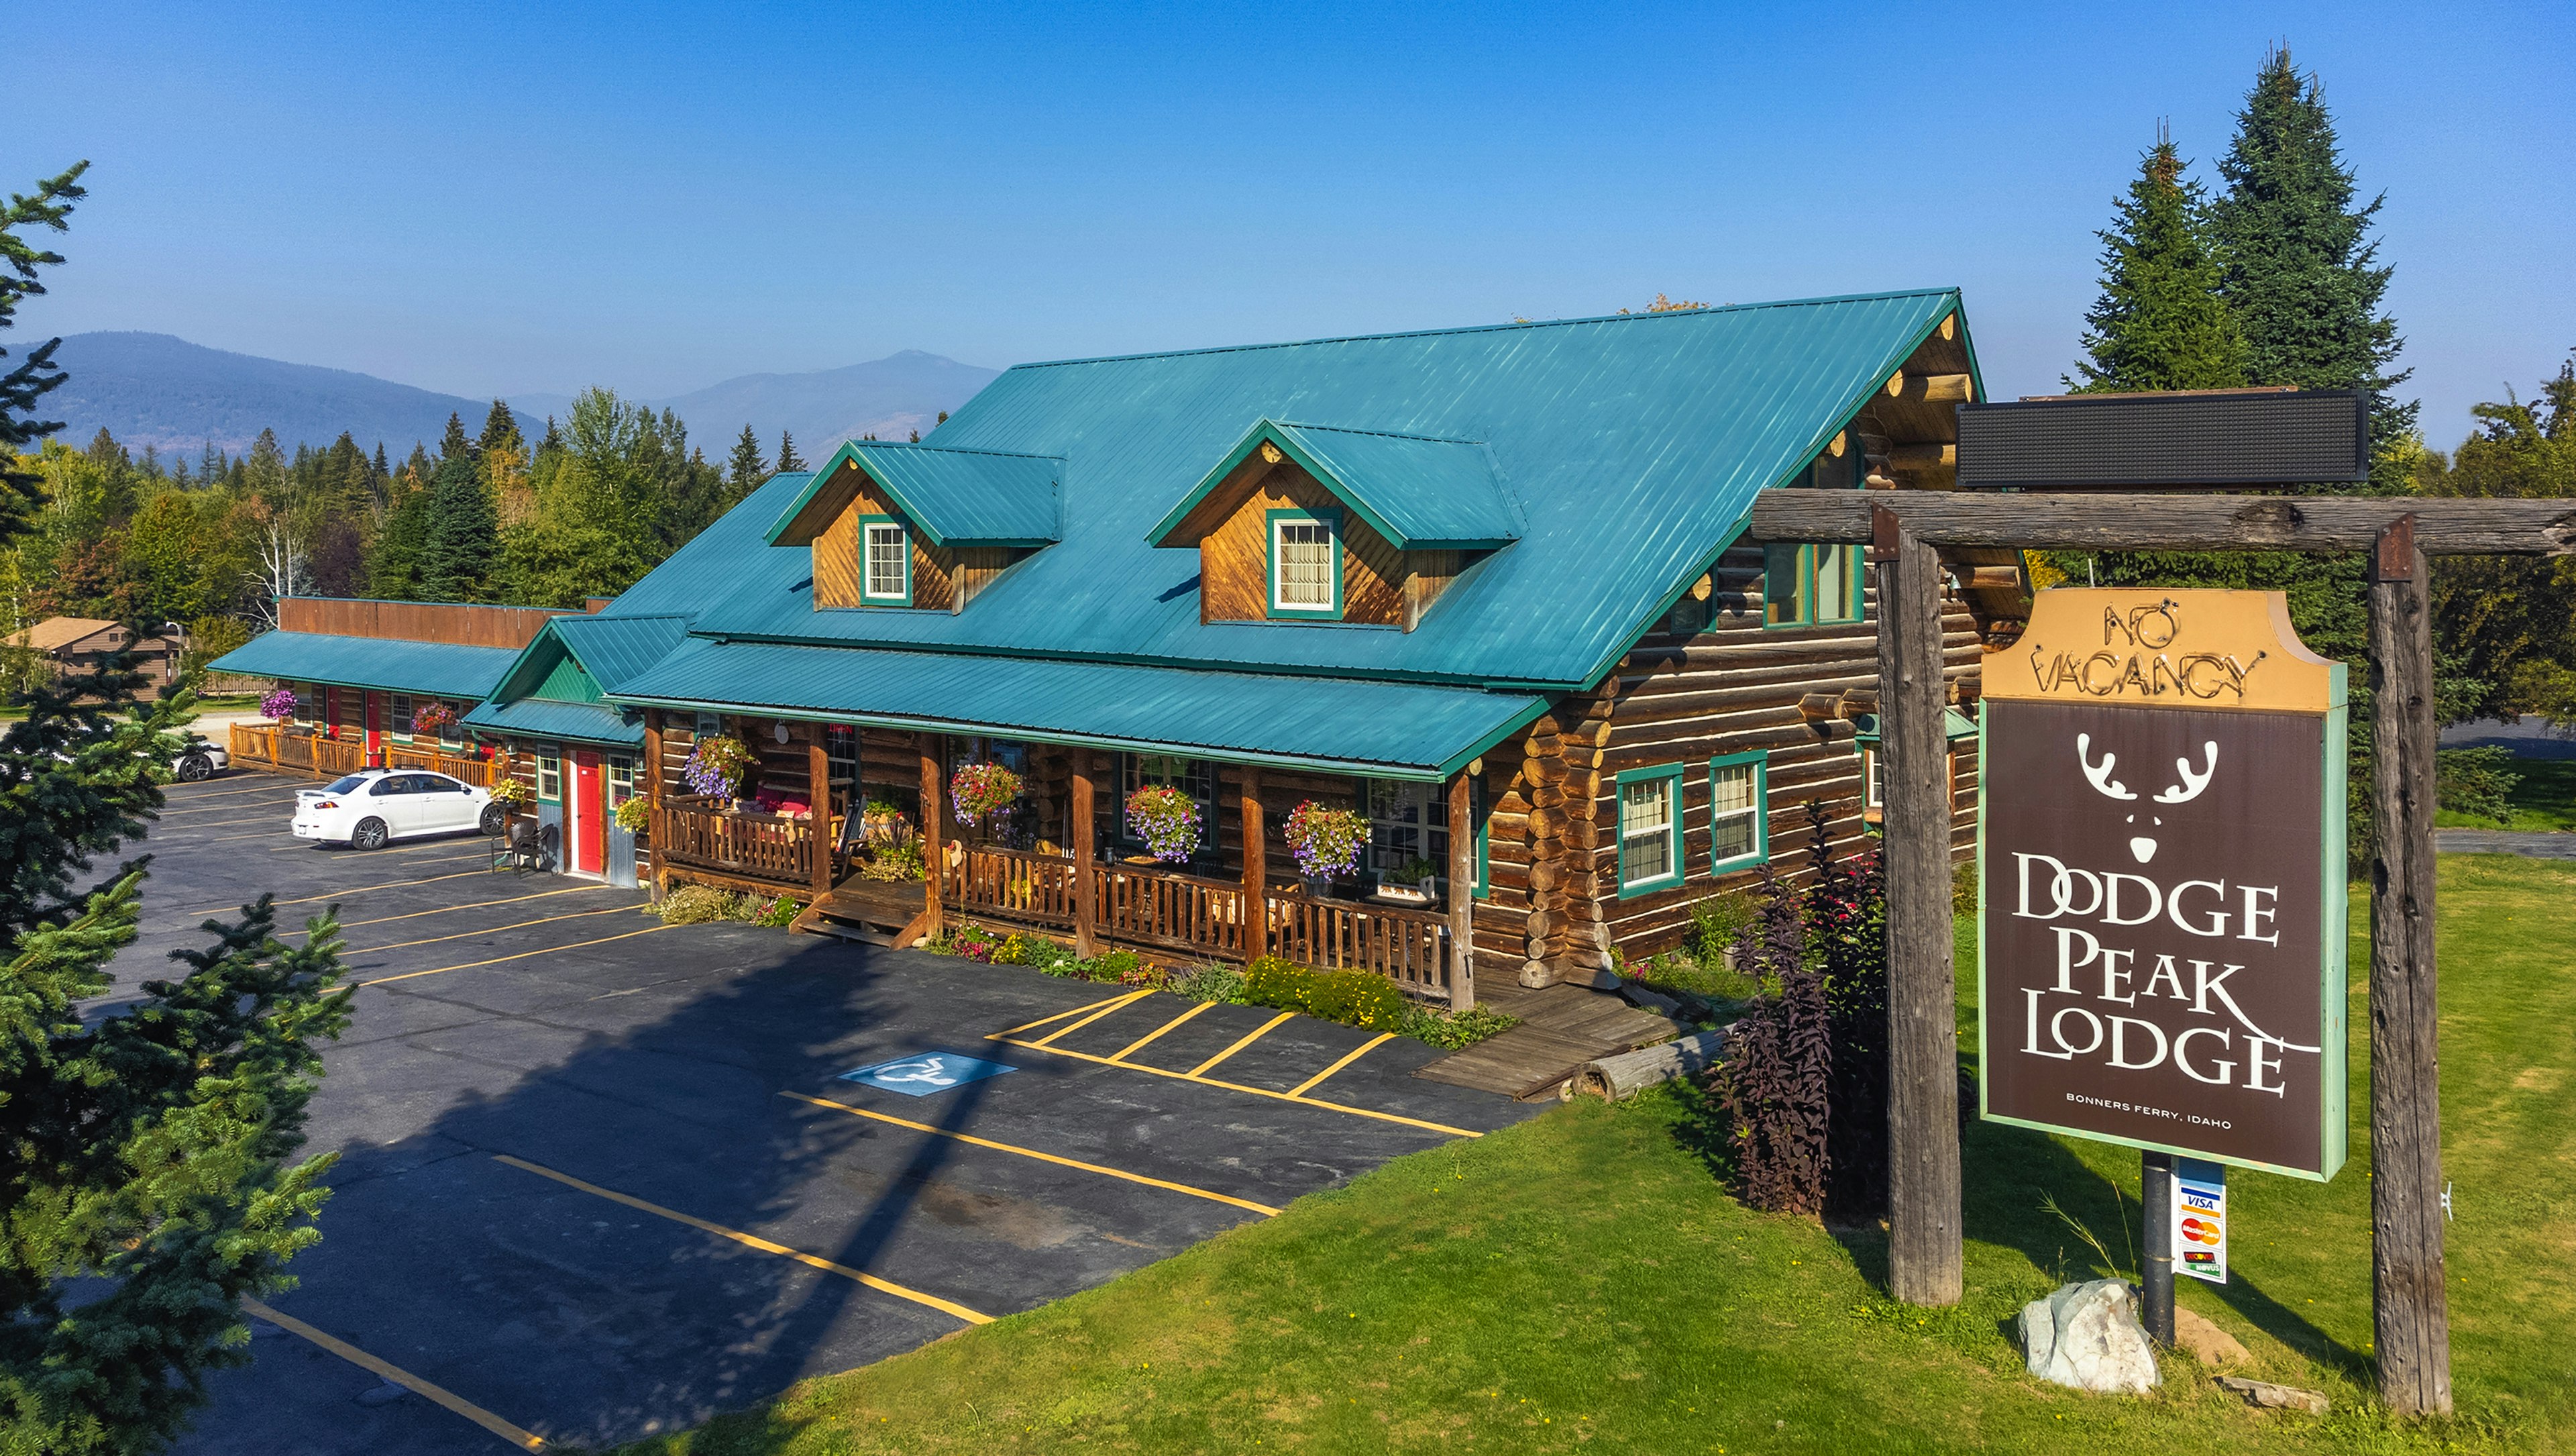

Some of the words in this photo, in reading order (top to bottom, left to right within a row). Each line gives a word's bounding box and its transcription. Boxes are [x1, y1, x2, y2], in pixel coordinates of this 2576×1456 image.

[2104, 599, 2179, 649] NO
[2031, 646, 2265, 699] VACANCY
[2011, 852, 2279, 947] DODGE
[2049, 926, 2321, 1053] PEAK
[2021, 988, 2286, 1098] LODGE
[2066, 1093, 2131, 1111] BONNERS
[2188, 1114, 2232, 1129] IDAHO
[2188, 1196, 2213, 1210] VISA
[2183, 1225, 2219, 1239] MasterCard
